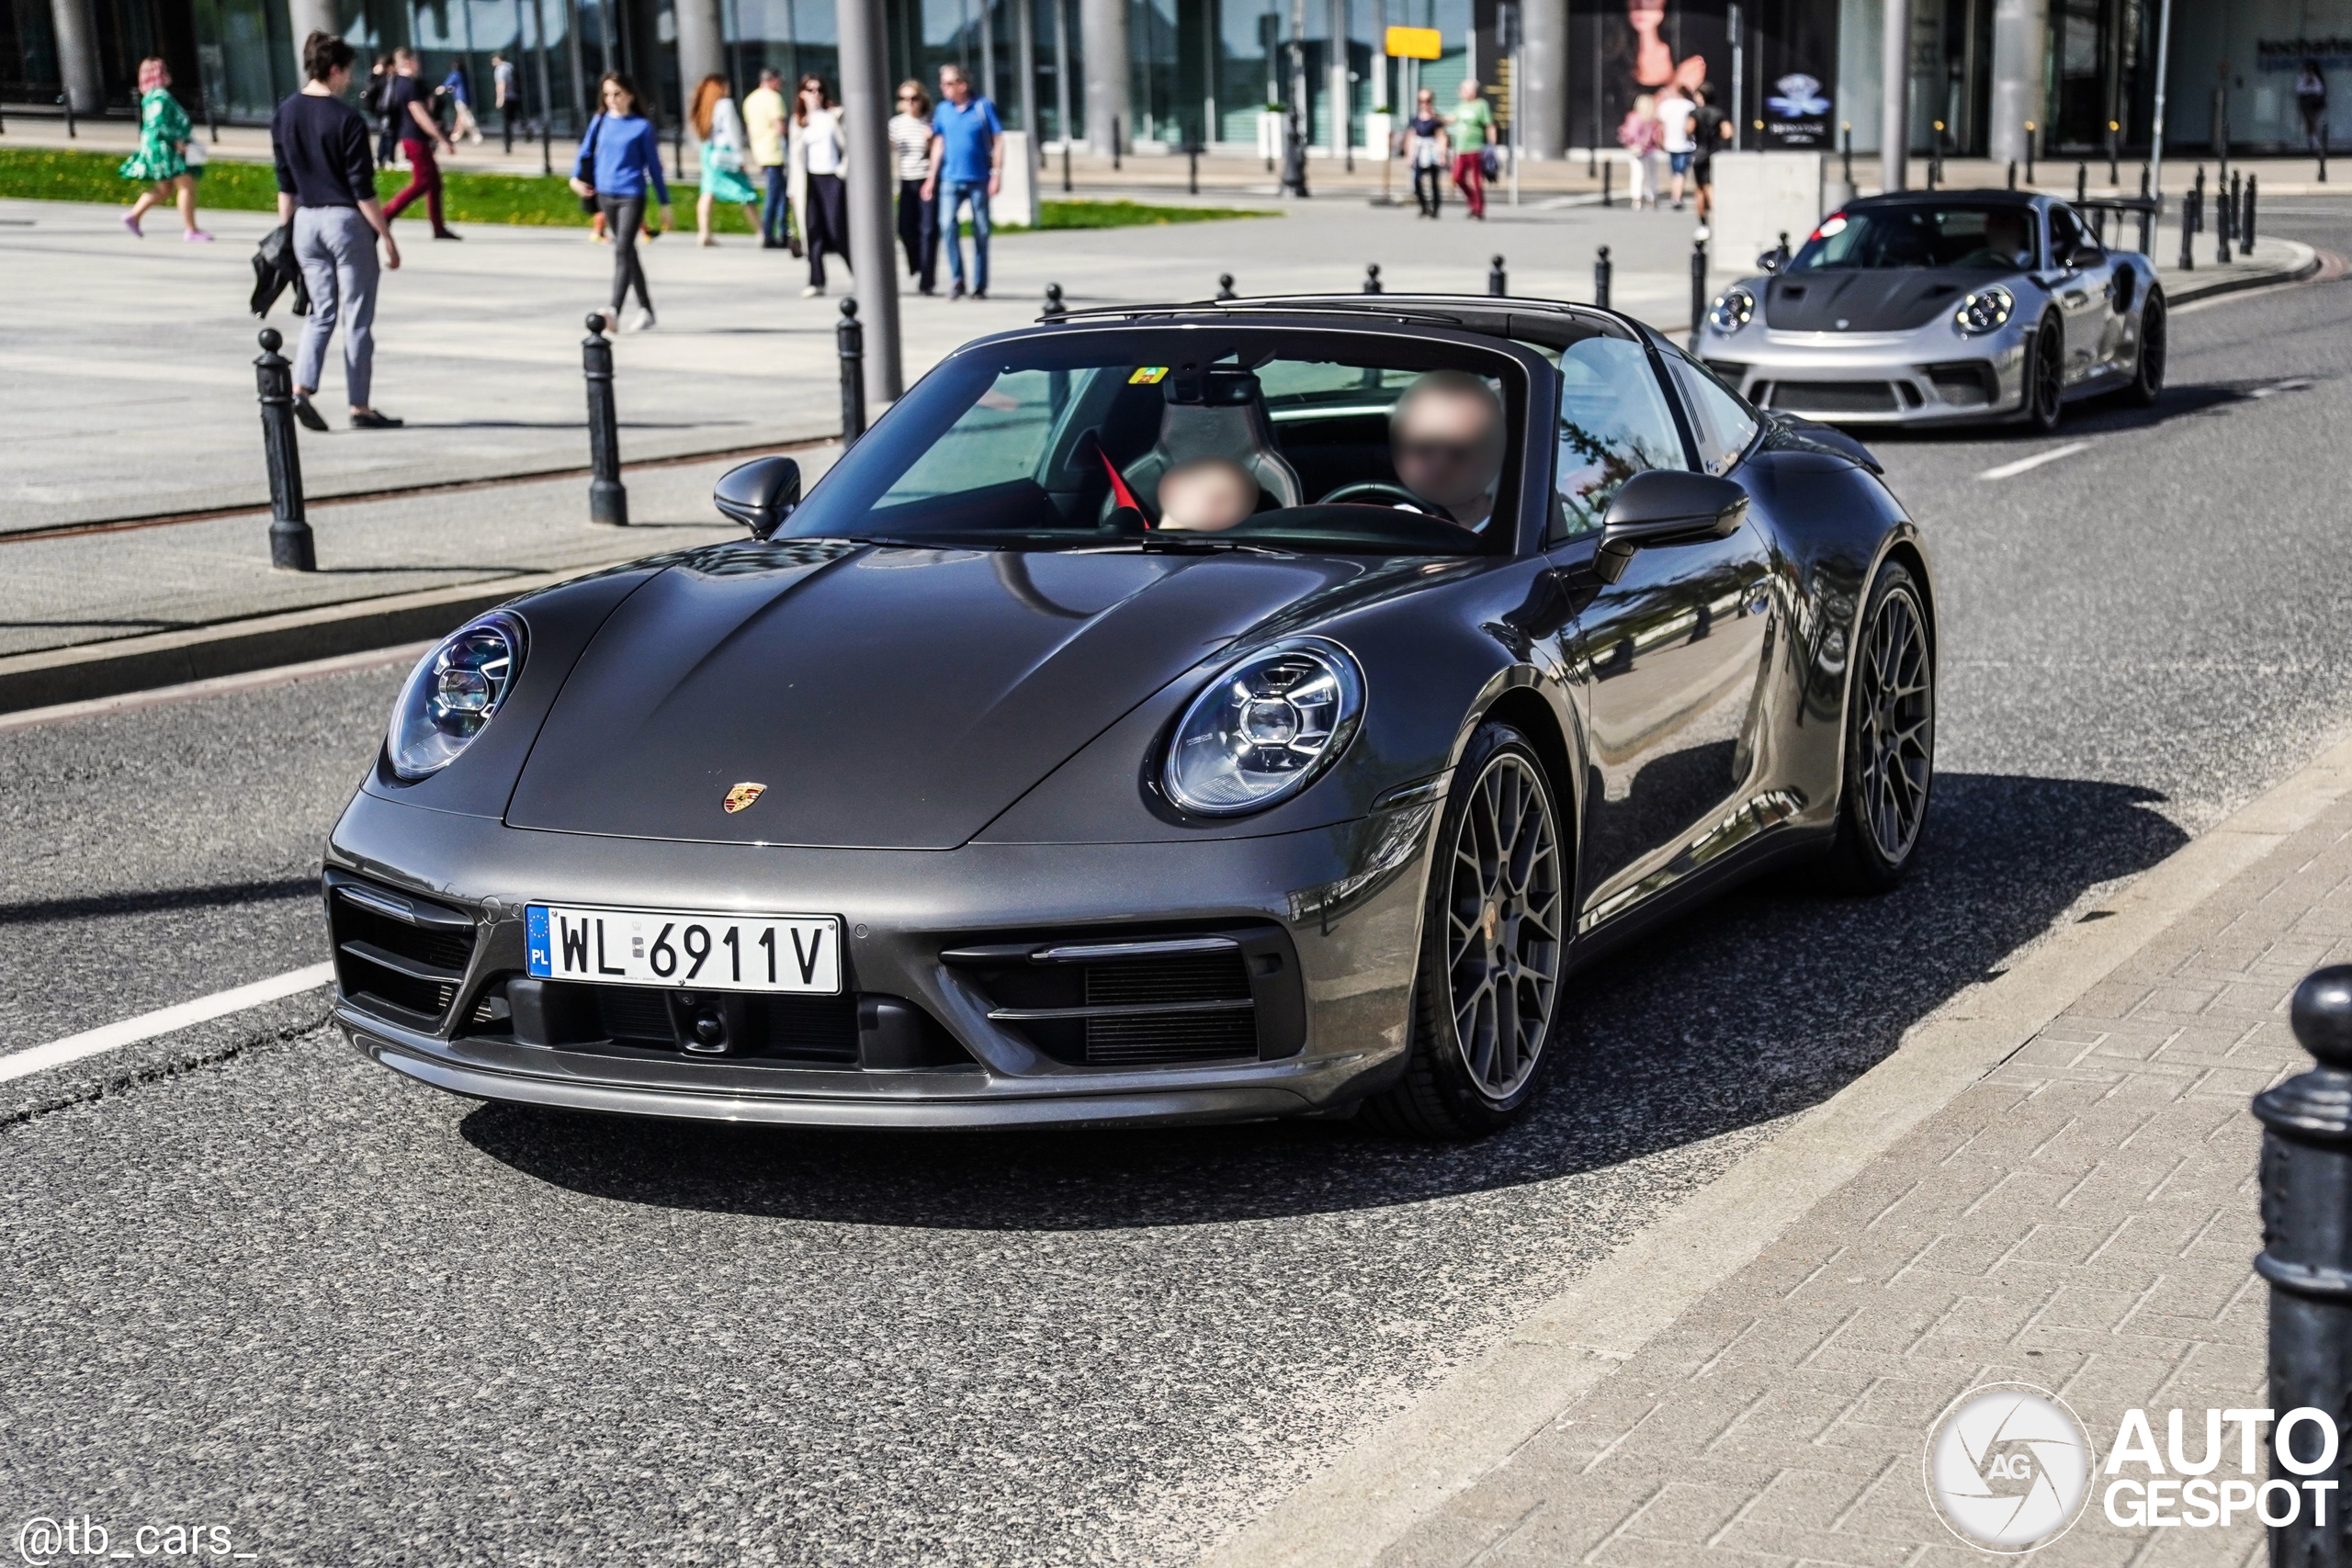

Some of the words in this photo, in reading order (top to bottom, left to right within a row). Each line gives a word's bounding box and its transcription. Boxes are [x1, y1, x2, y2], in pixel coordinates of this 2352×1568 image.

[531, 949, 548, 965] PL
[560, 916, 626, 976] WL
[650, 922, 822, 985] 6911V
